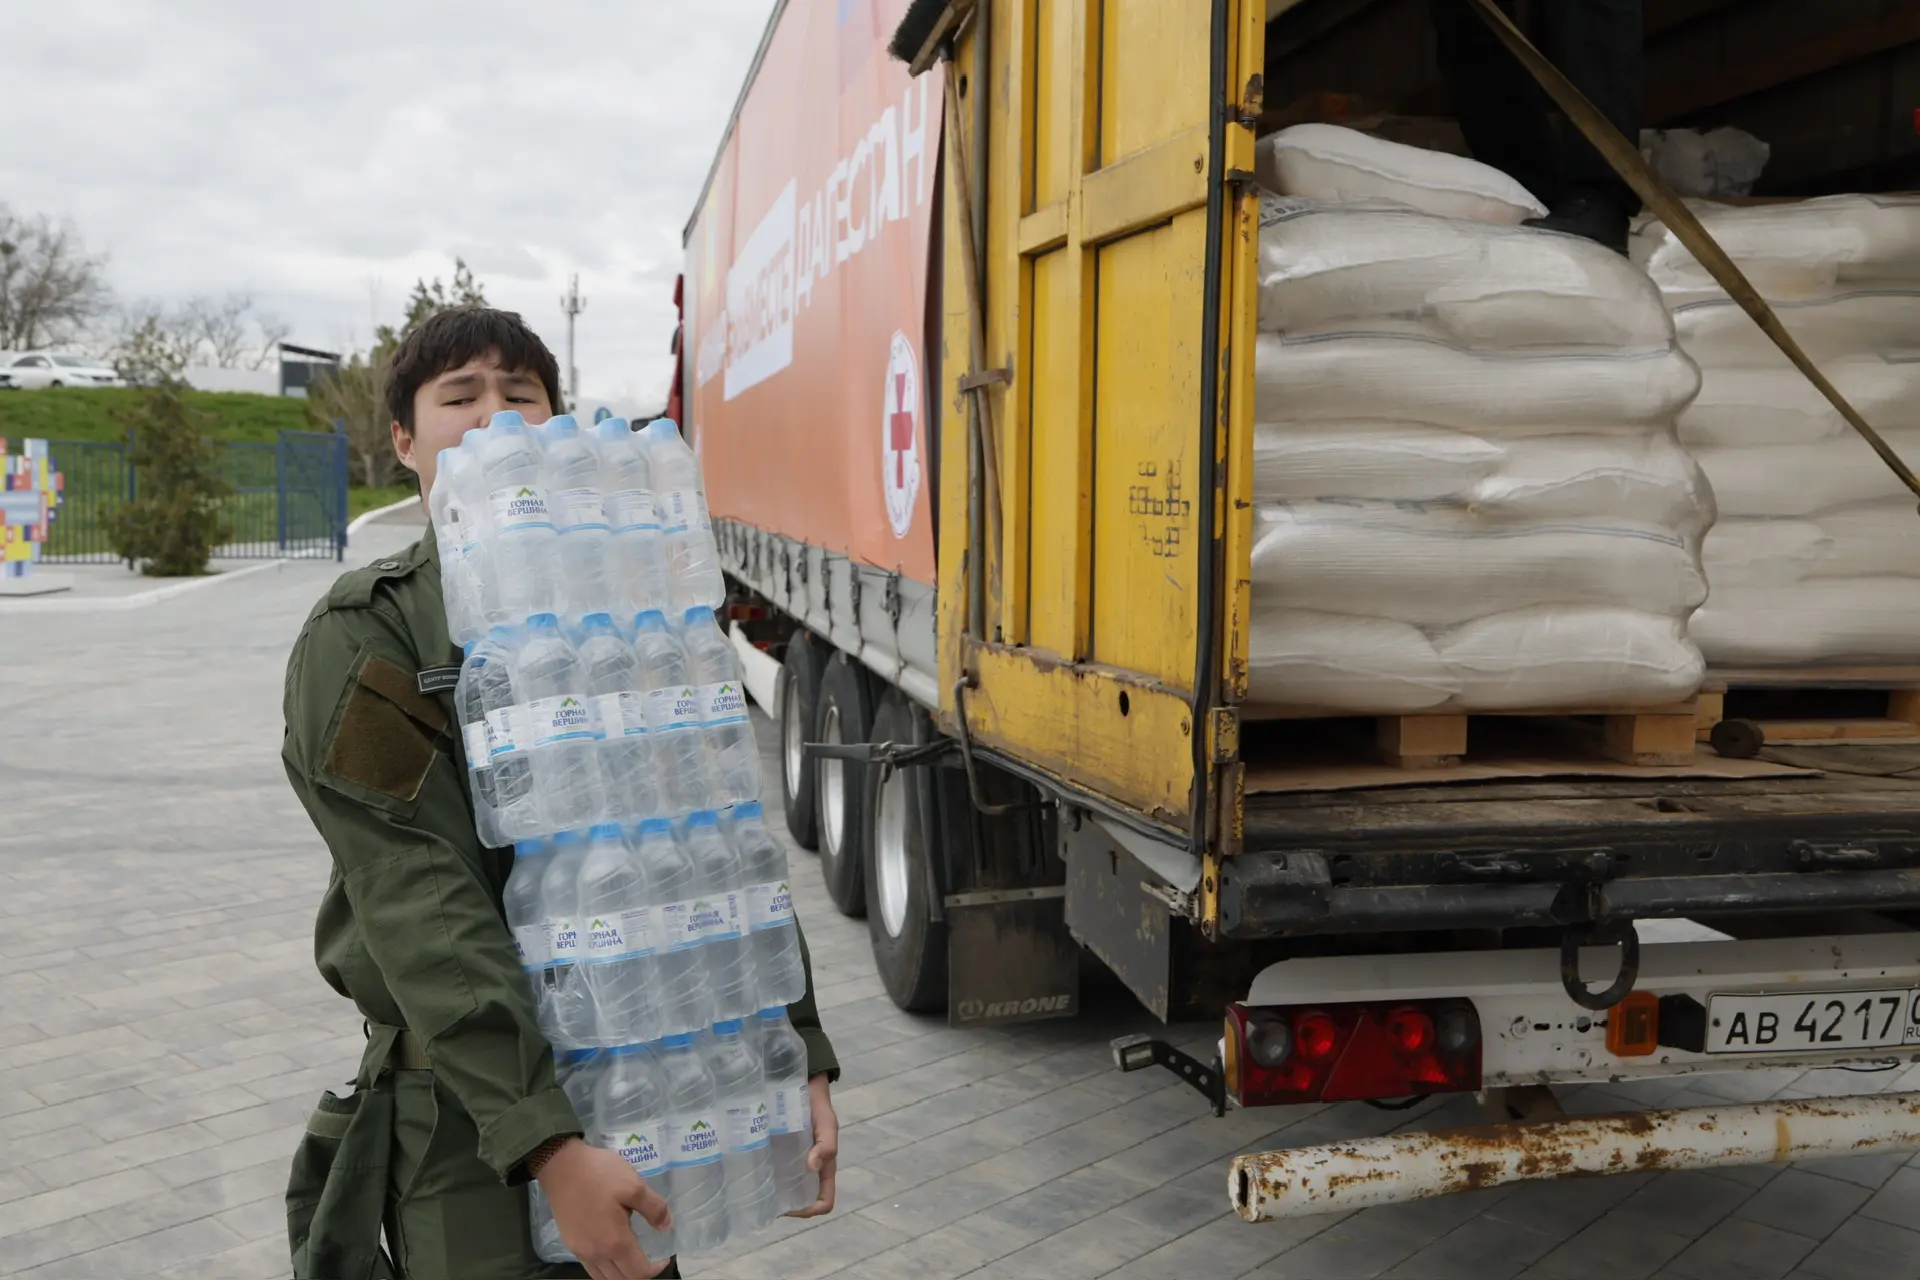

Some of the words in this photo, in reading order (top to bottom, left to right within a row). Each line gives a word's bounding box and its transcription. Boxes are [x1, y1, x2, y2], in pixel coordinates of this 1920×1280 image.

[795, 71, 928, 318] ДАГЕСТАН
[510, 499, 544, 508] ГОРНАЯ
[507, 506, 548, 516] ВЕРШИНА
[555, 709, 586, 719] ГОРНАЯ
[558, 931, 577, 941] ГОРН
[589, 929, 617, 940] ОРНАЯ
[588, 937, 623, 949] ЕРШИНА
[986, 995, 1070, 1017] KRONE
[1794, 997, 1900, 1042] 4217
[1906, 1026, 1920, 1038] RU
[685, 1130, 715, 1143] ГОРНАЯ
[619, 1144, 653, 1157] ГОРНАЯ
